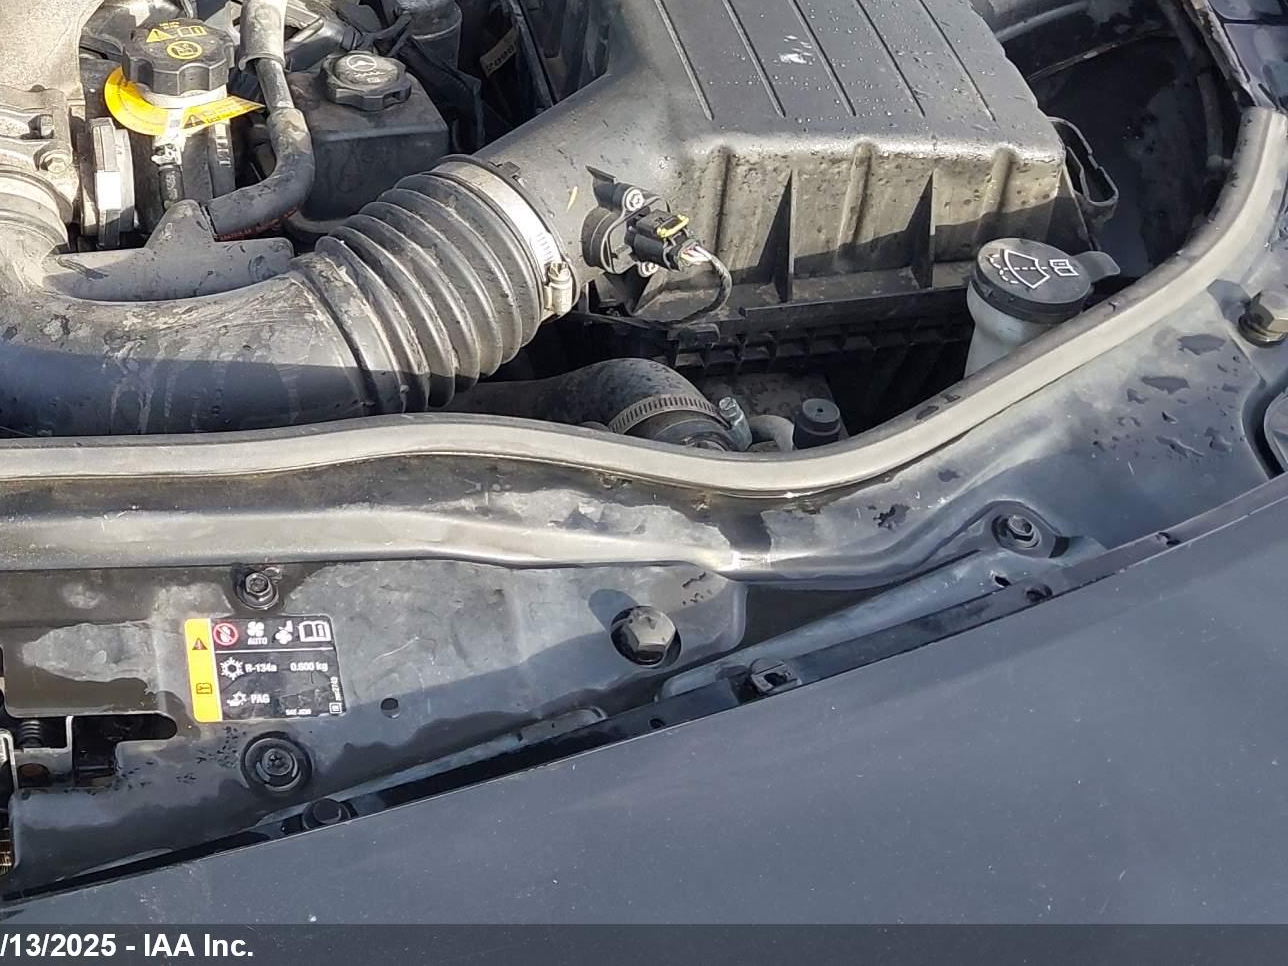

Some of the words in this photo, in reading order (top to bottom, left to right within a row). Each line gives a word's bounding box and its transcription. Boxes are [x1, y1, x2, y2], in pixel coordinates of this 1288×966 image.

[247, 637, 268, 645] AUTO
[244, 662, 278, 673] R-134a
[315, 661, 329, 672] kg
[250, 693, 270, 704] PAG
